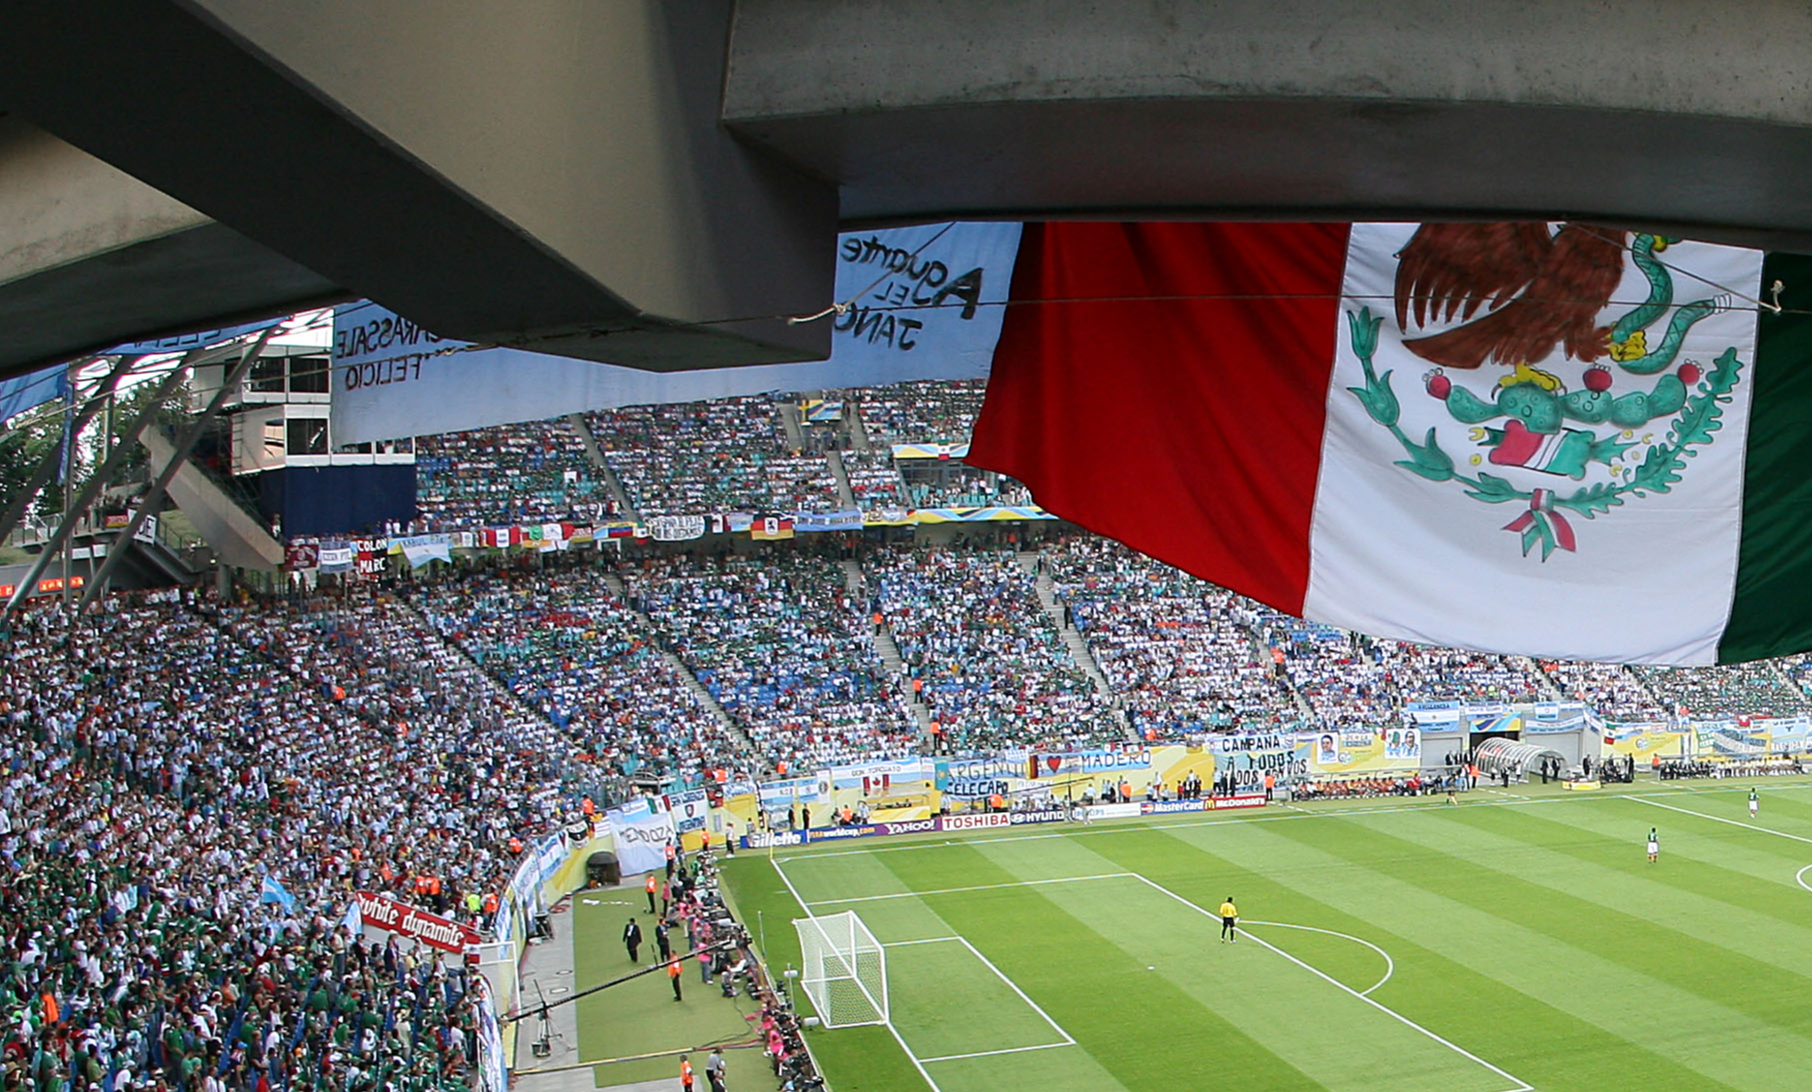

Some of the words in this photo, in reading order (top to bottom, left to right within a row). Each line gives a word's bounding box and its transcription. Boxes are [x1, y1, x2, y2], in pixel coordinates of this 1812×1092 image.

[357, 539, 388, 552] COLON
[1222, 734, 1281, 753] CAMPANA
[1082, 750, 1151, 768] MADERO
[1154, 799, 1204, 812] MasterCard
[884, 820, 936, 835] YAHOO!
[943, 812, 1010, 829] TOSHIBA
[750, 830, 802, 848] Gillette
[402, 910, 465, 947] dynamite
